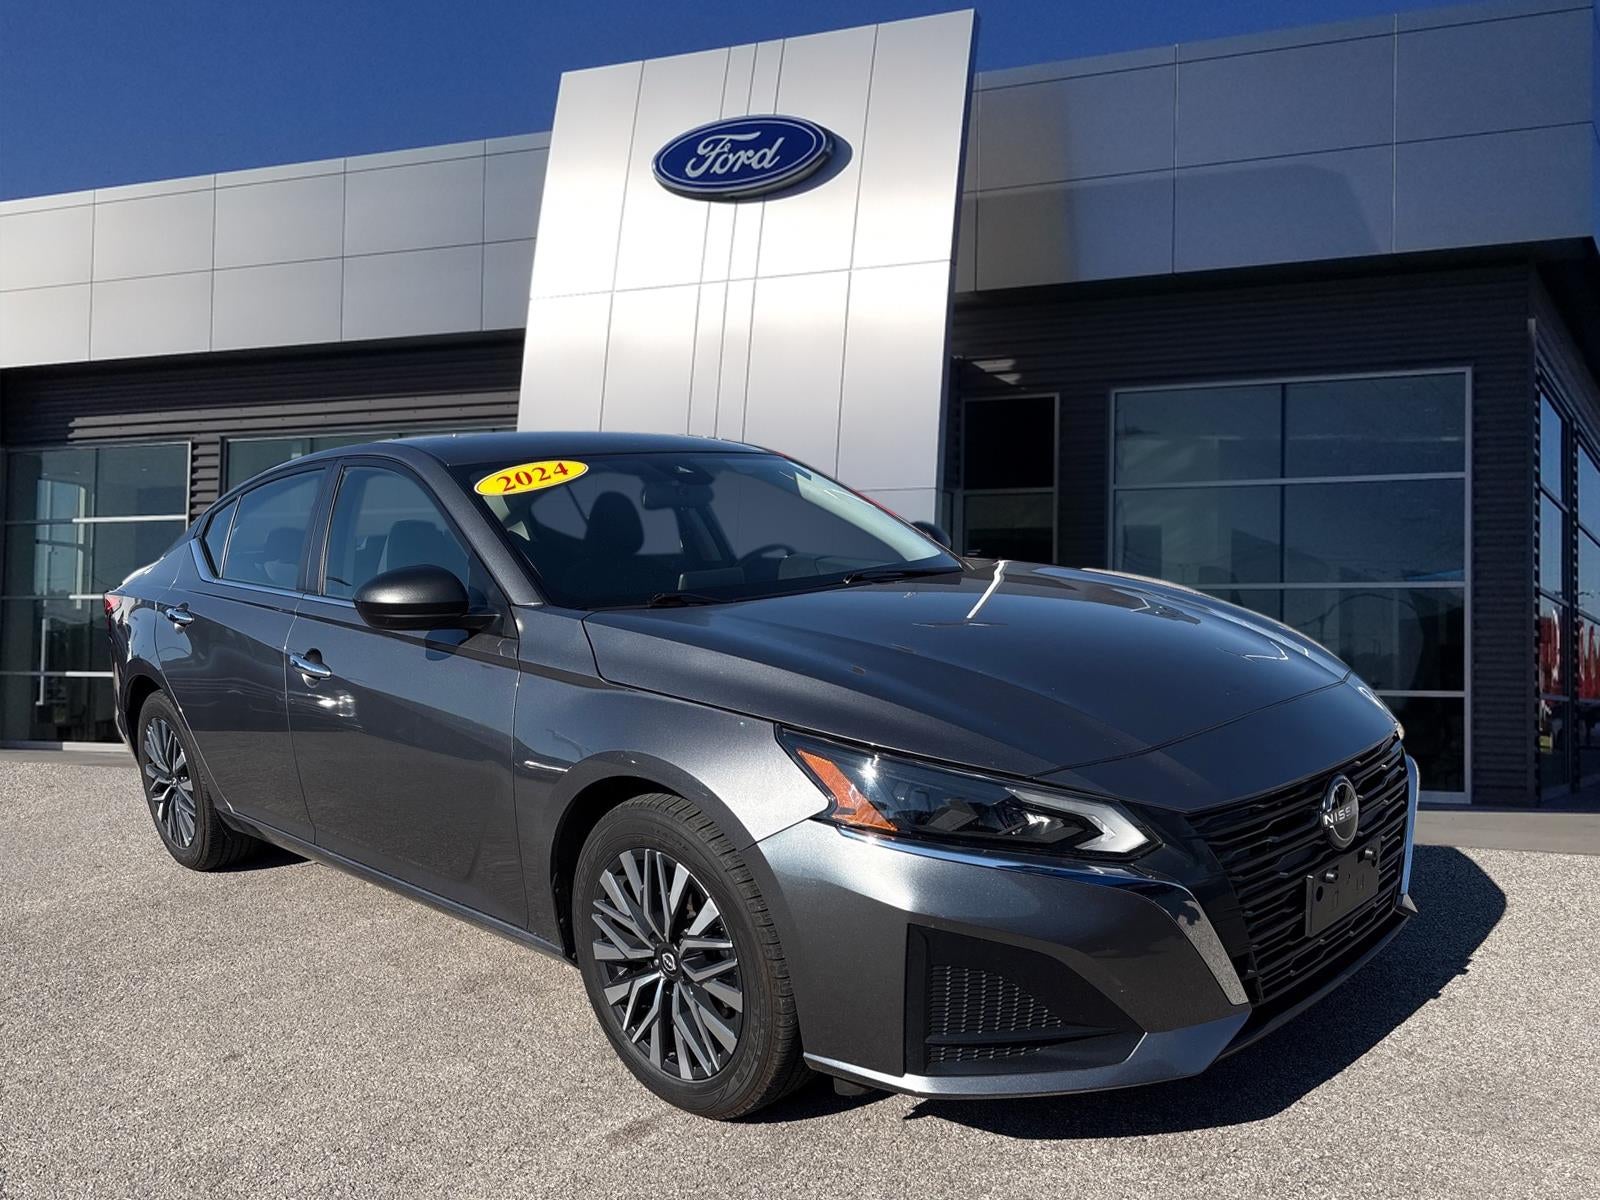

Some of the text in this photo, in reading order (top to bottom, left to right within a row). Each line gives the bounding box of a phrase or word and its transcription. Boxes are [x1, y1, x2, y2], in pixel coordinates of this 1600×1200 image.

[685, 131, 785, 178] Ford
[496, 462, 569, 492] 2024
[1324, 805, 1352, 825] NISS
